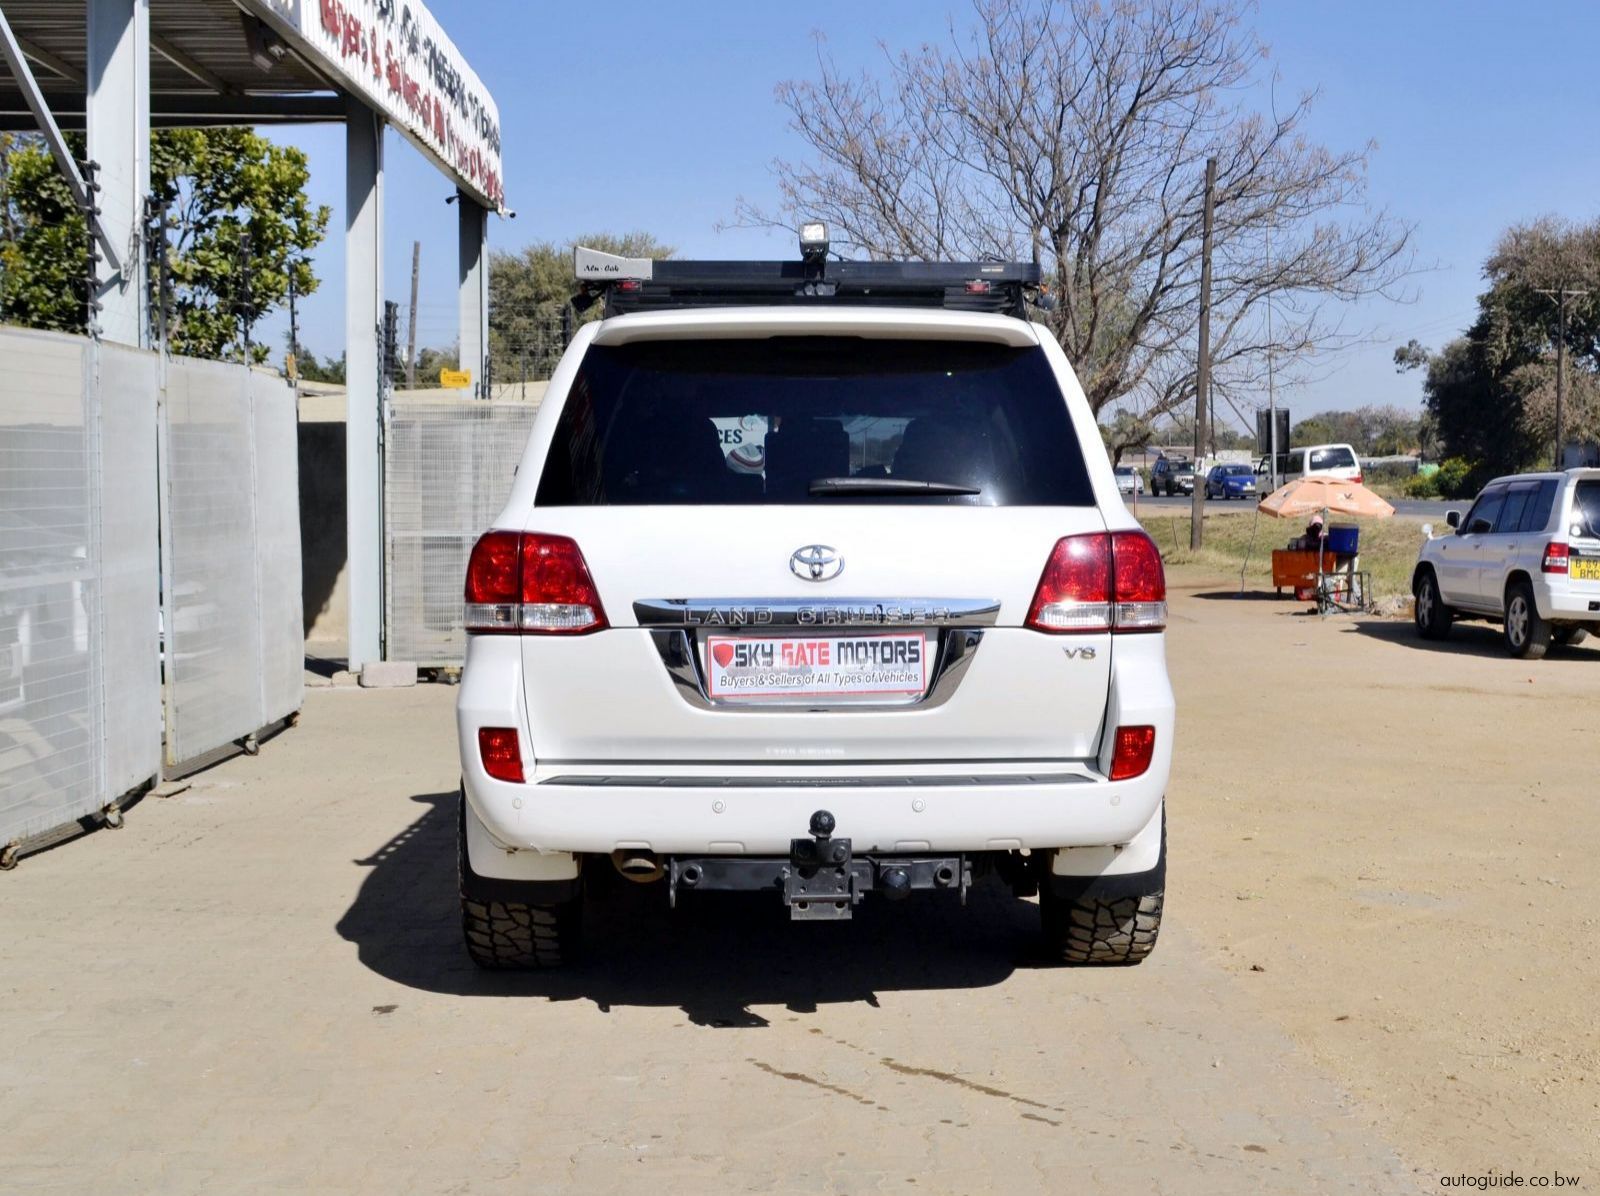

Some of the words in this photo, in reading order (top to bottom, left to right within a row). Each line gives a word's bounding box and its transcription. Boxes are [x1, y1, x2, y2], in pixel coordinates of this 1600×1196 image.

[683, 607, 774, 625] LAND
[796, 606, 951, 626] CRUISER
[735, 643, 774, 667] SKY
[782, 642, 830, 666] GATE
[838, 640, 920, 665] MOTORS
[1061, 646, 1096, 660] V8
[720, 675, 756, 689] Buyers
[758, 674, 766, 686] &
[768, 673, 804, 686] Sellers
[805, 673, 816, 685] of
[817, 672, 831, 684] All
[834, 672, 862, 686] Types
[865, 671, 876, 683] of
[878, 671, 920, 684] Vehicles
